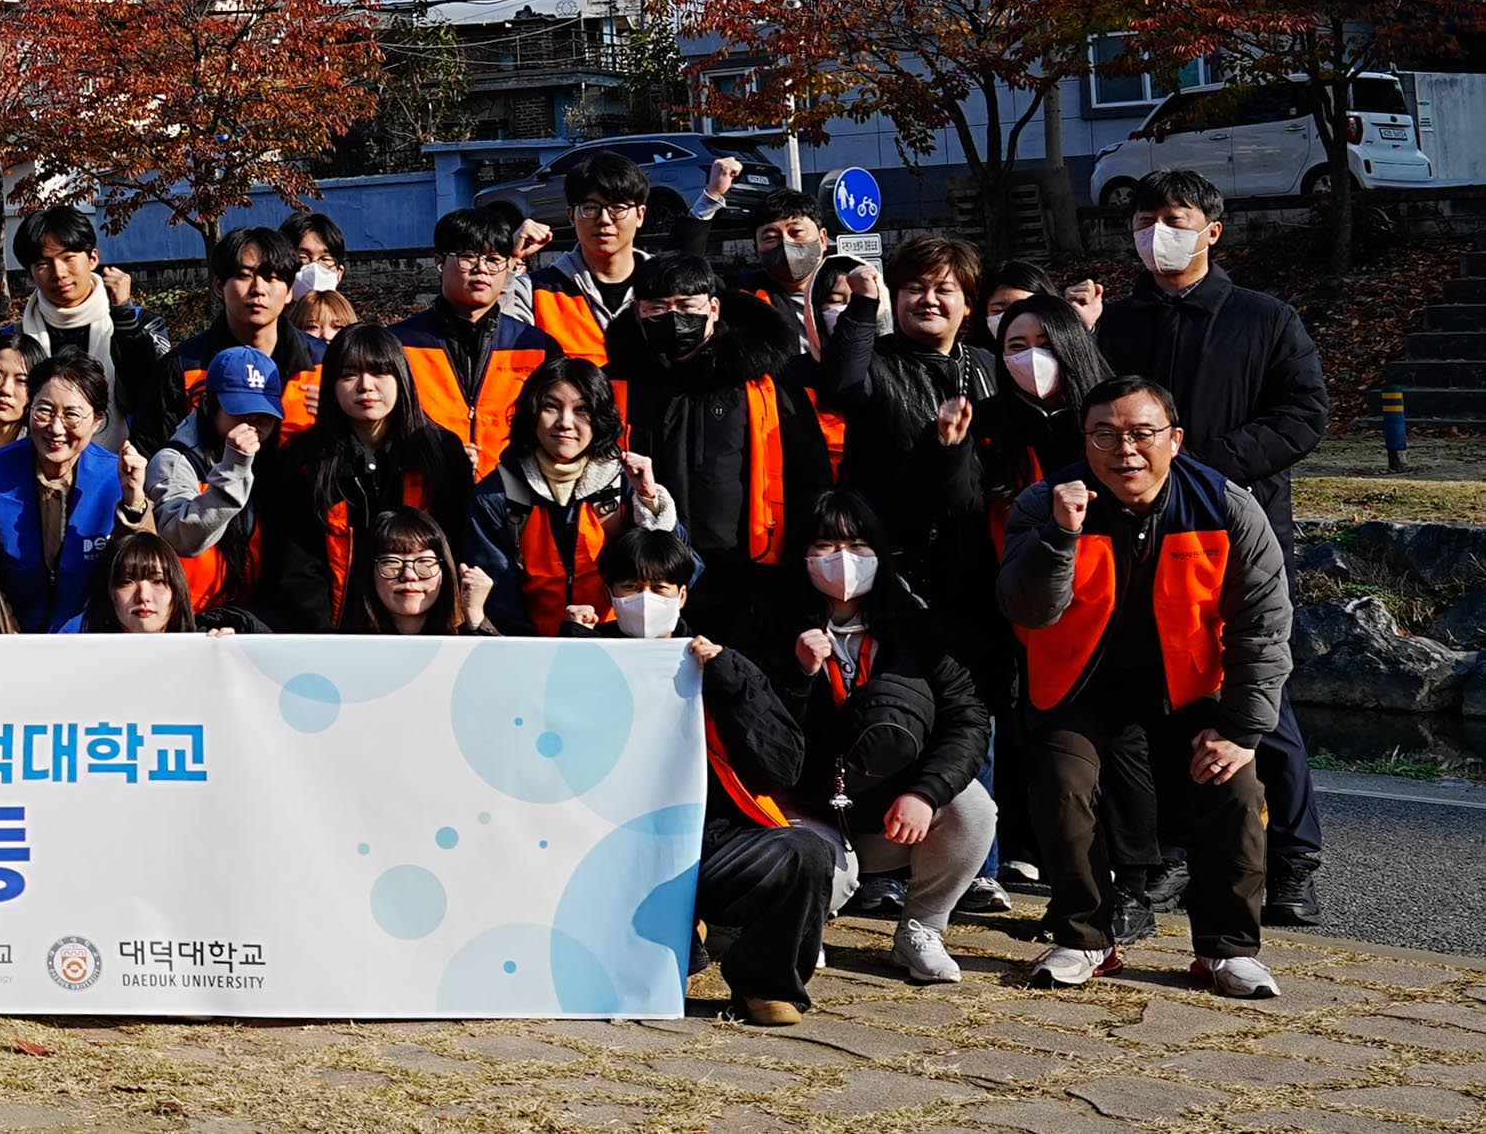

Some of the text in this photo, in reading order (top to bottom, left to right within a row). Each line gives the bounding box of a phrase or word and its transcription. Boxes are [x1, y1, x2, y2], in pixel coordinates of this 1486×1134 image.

[246, 364, 265, 388] LA
[119, 940, 266, 973] 대덕대학교
[122, 973, 265, 989] DAEDUK UNIVERSITY
